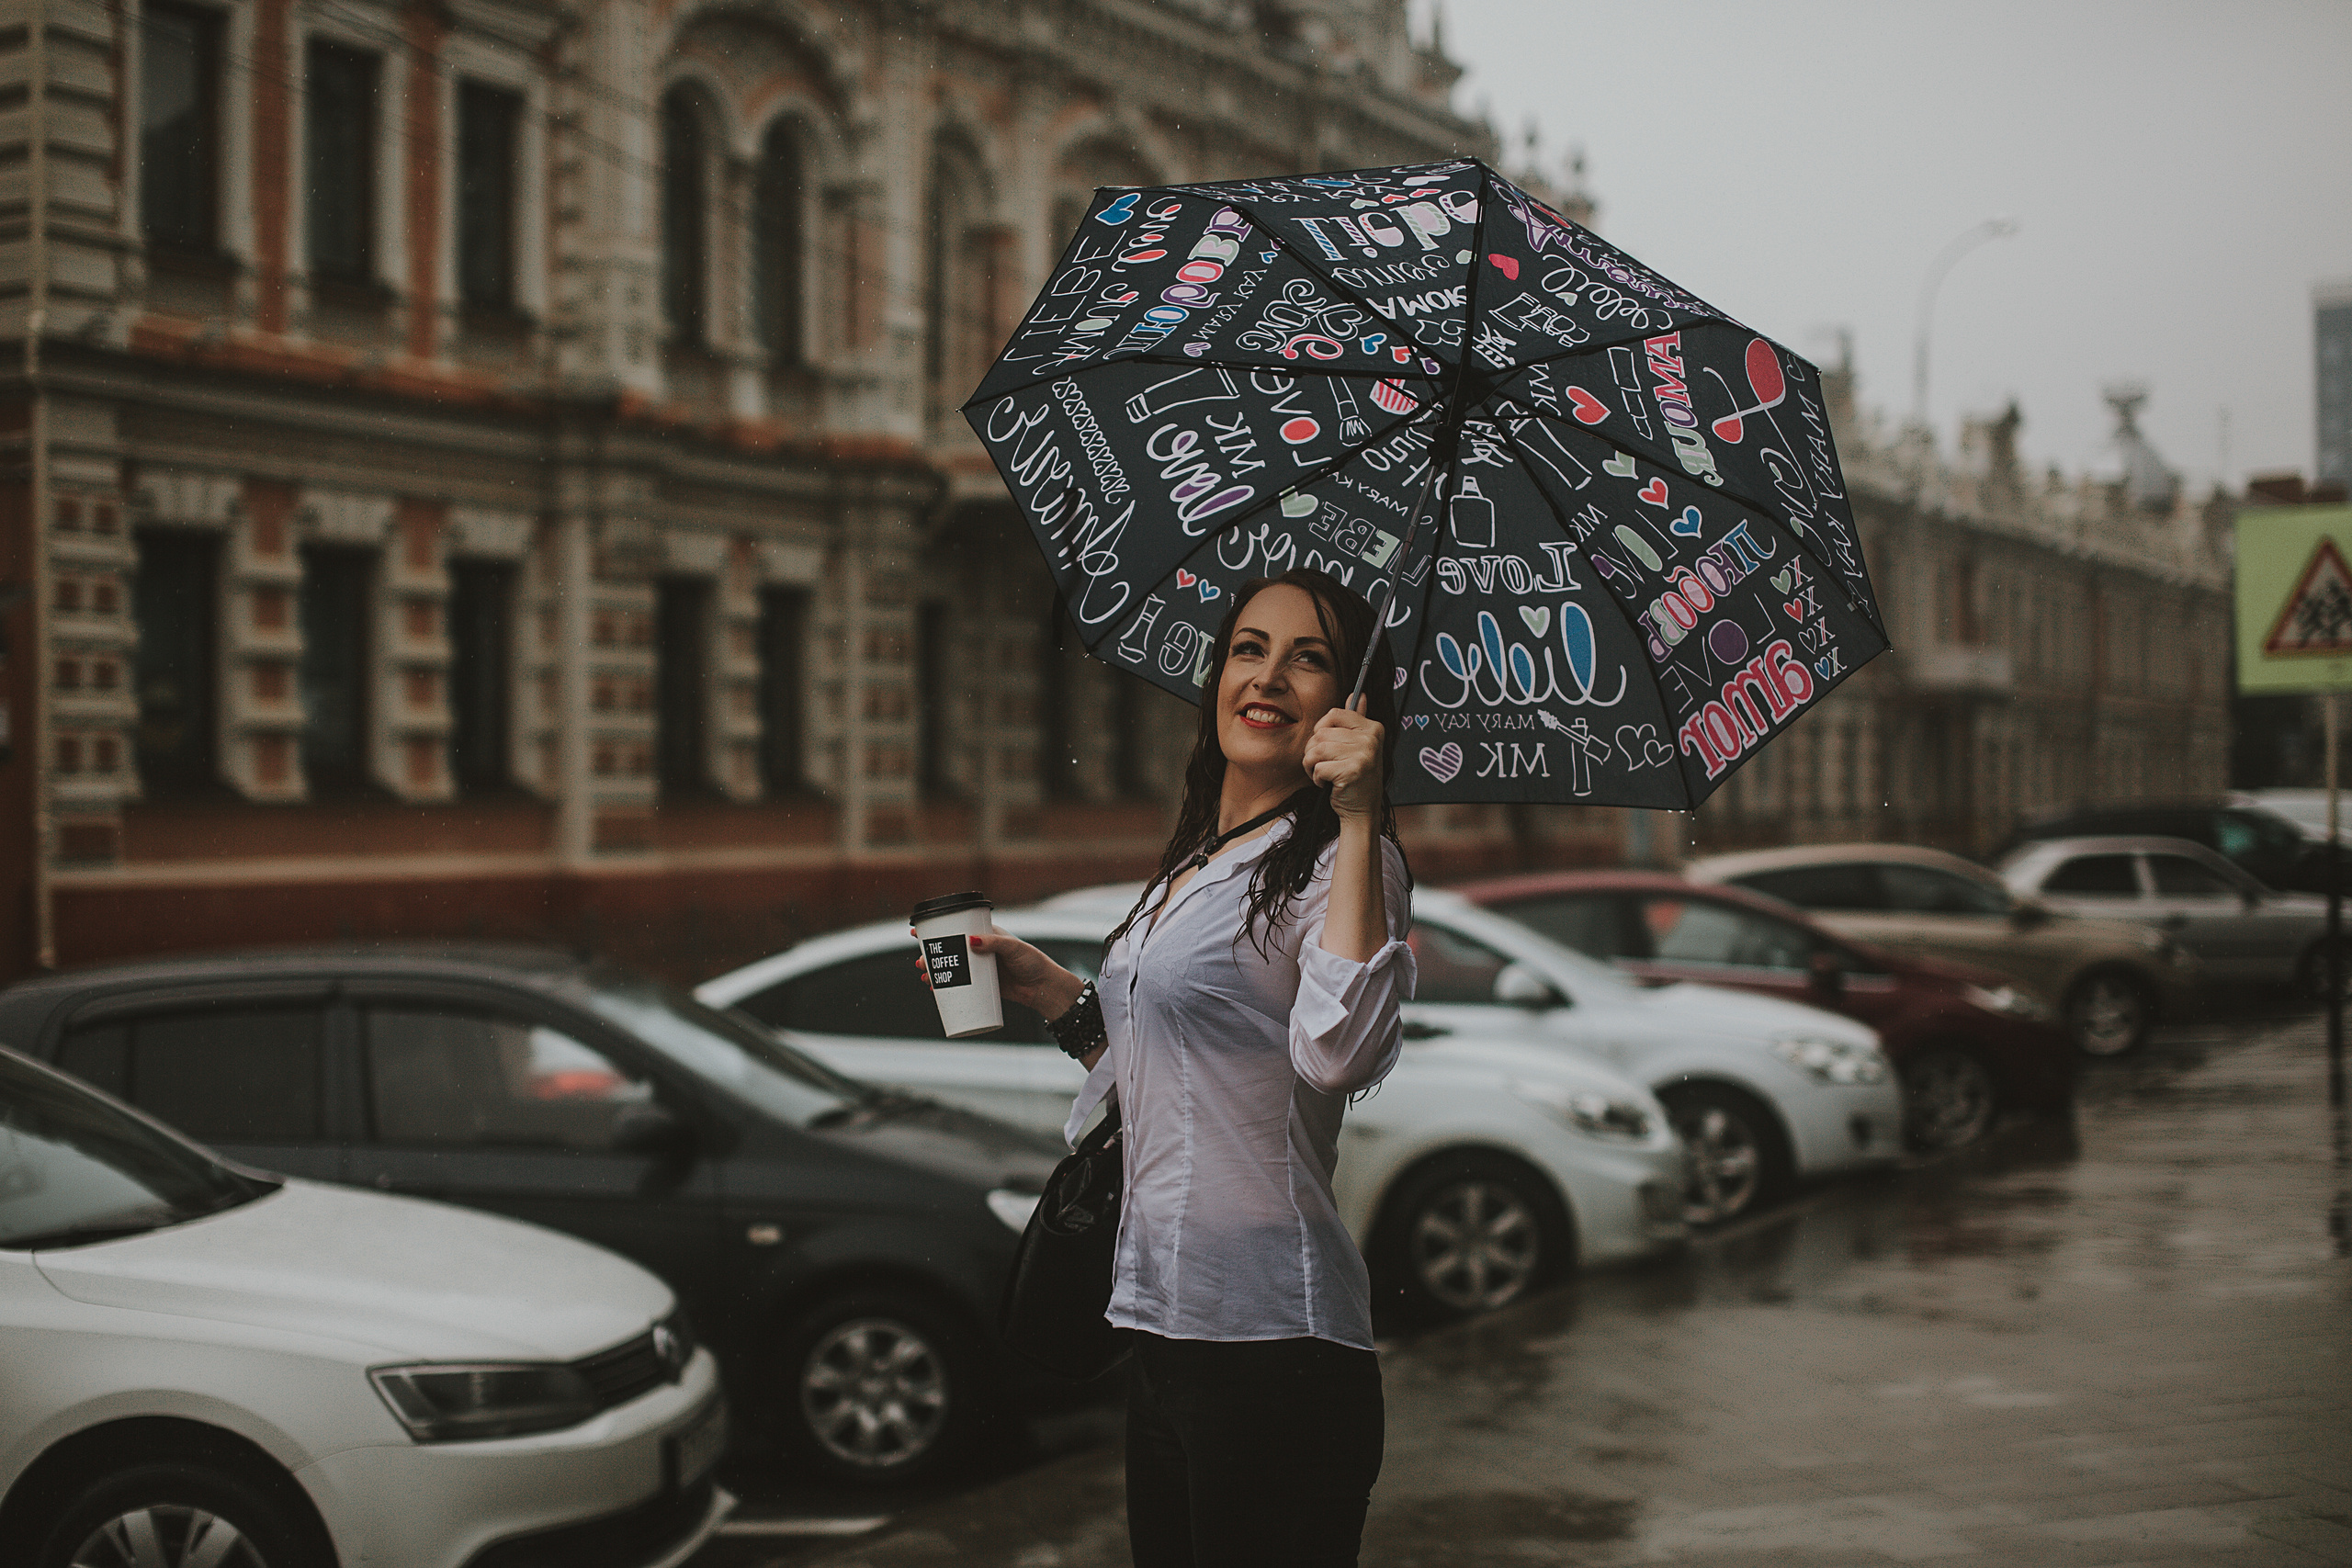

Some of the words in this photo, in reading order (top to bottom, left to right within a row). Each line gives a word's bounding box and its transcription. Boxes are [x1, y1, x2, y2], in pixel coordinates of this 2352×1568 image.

[928, 942, 944, 954] THE
[931, 954, 960, 969] COFFEE
[933, 971, 953, 984] SHOP
